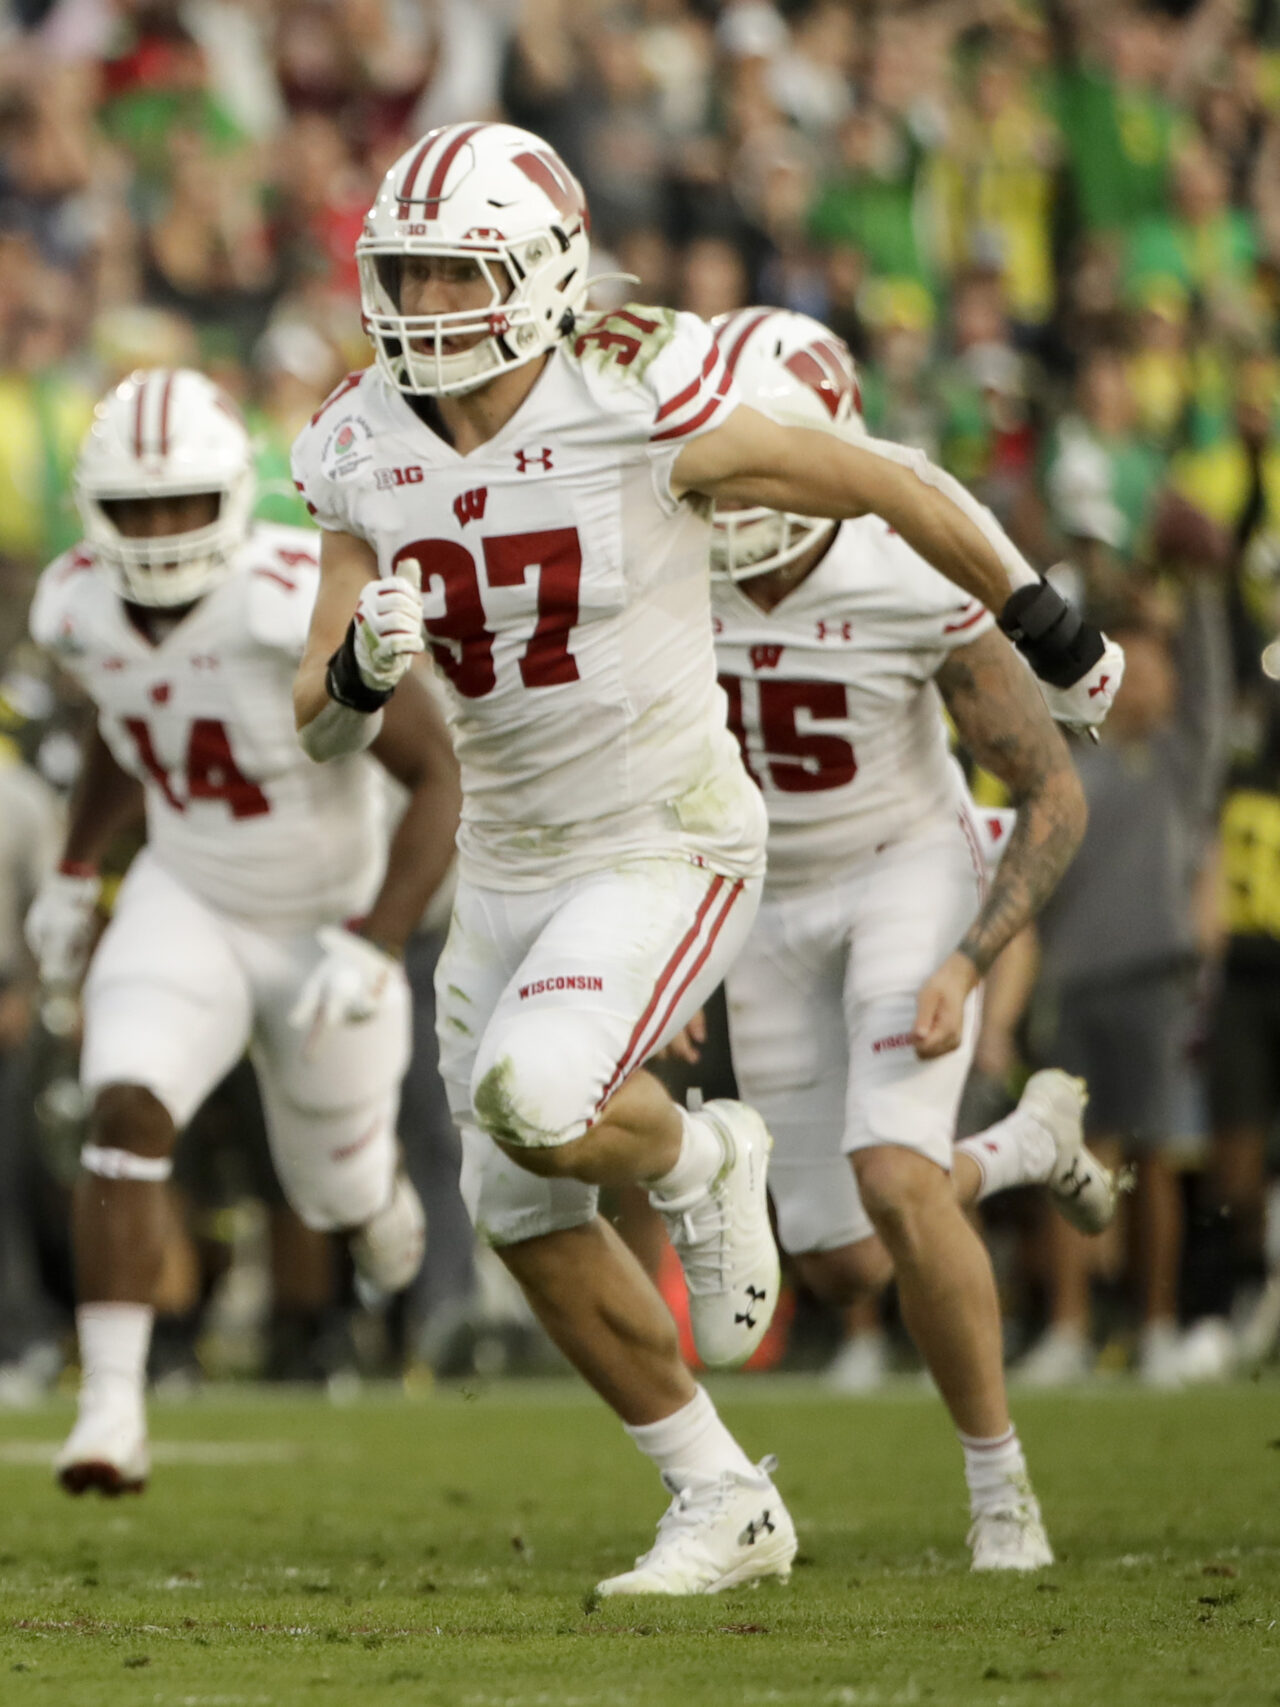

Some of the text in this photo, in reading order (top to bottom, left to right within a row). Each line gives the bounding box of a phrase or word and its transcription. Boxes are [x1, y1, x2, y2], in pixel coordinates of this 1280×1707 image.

[452, 485, 488, 529] W
[391, 525, 583, 700] 37
[121, 716, 271, 822] 14
[518, 975, 604, 1001] WISCONSIN
